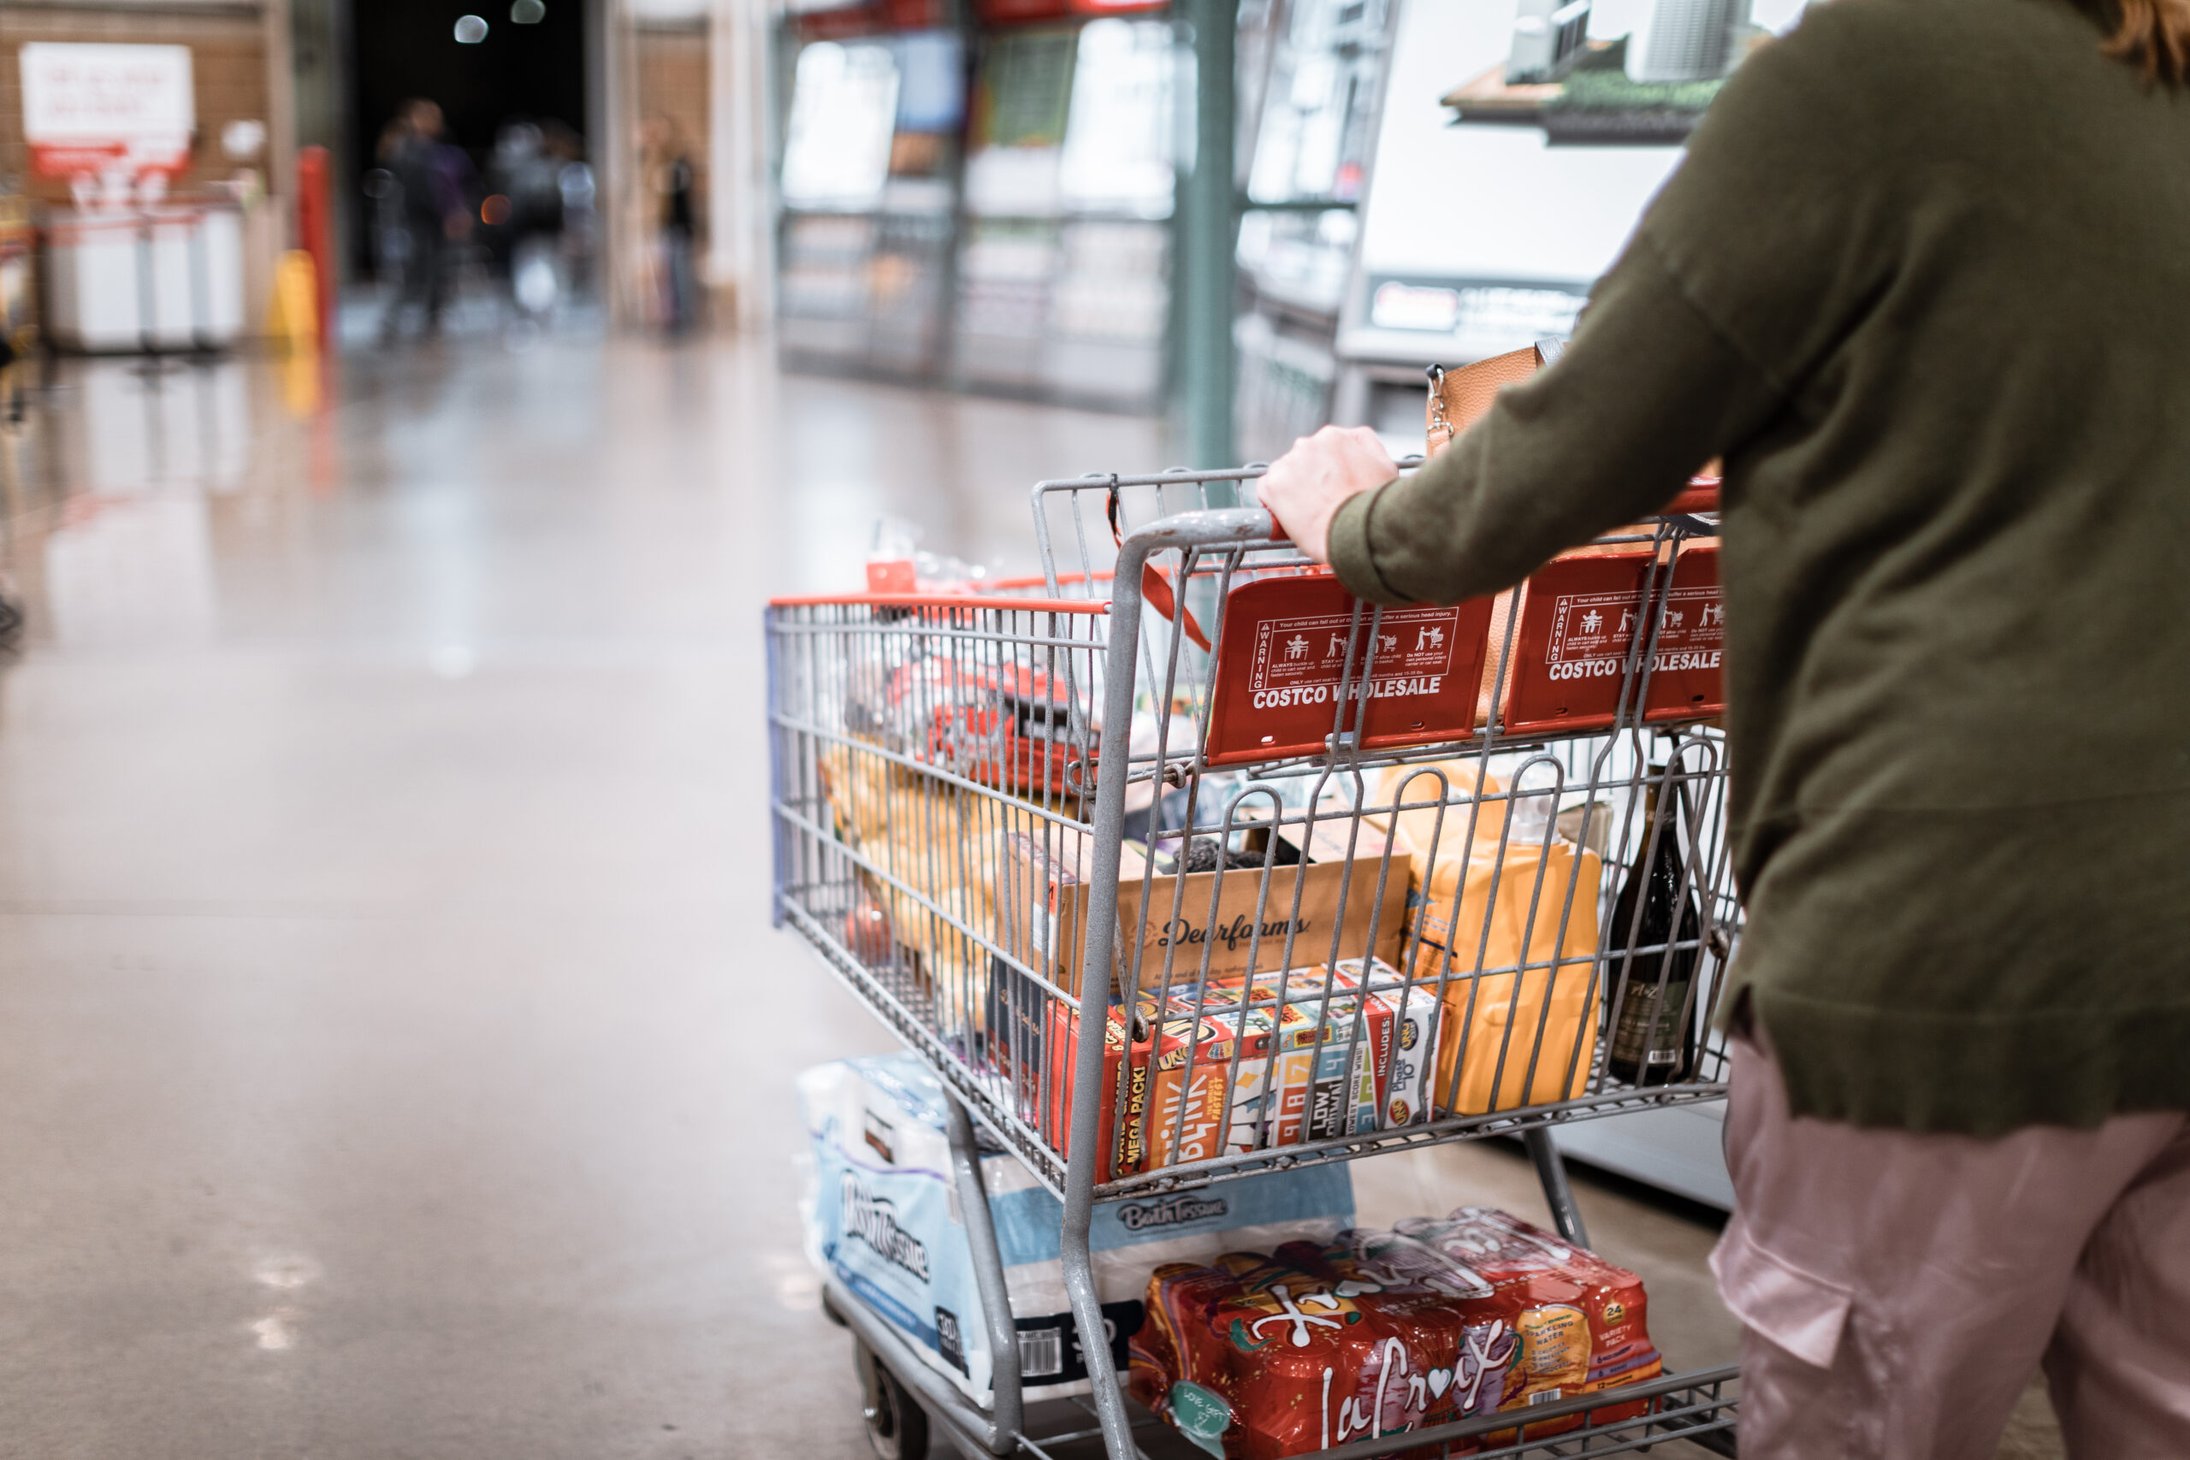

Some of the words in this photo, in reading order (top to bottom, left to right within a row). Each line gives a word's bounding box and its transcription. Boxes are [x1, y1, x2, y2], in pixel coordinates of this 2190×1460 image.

[1551, 606, 1567, 661] WARNING
[1254, 631, 1270, 688] WARNING
[1549, 659, 1617, 681] COSTCO
[1253, 686, 1327, 709] COSTCO
[1332, 676, 1442, 701] WHOLESALE
[1377, 1016, 1391, 1077] INCLUDES:
[1130, 1066, 1146, 1114] PACK!
[1211, 1076, 1224, 1120] FASTEST
[1312, 1092, 1330, 1130] LOW
[1393, 1099, 1408, 1125] UNO
[1127, 1116, 1141, 1164] MEGA
[1607, 1305, 1622, 1316] 24
[1599, 1324, 1633, 1341] VARIETY
[1605, 1334, 1626, 1348] PACK
